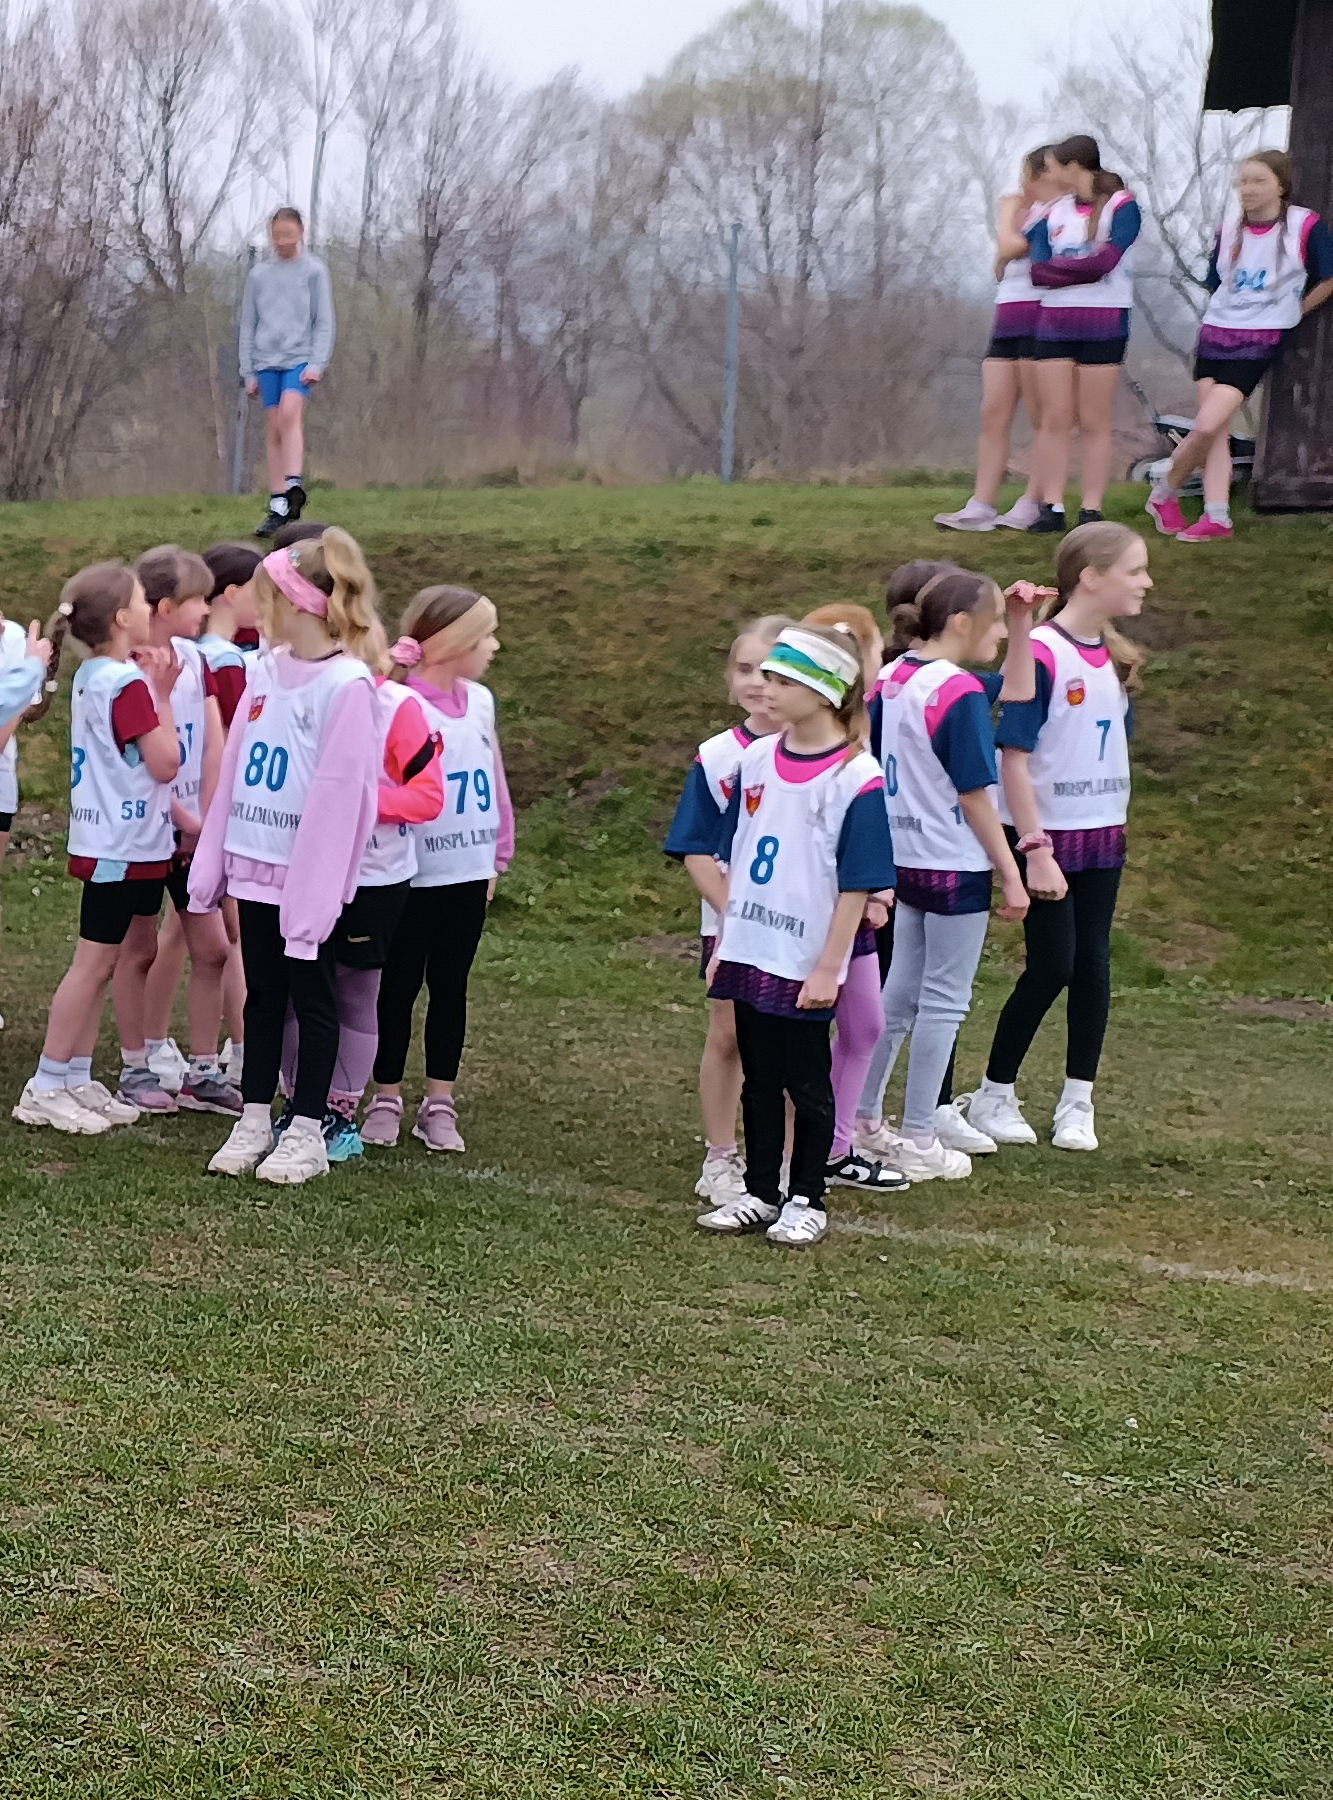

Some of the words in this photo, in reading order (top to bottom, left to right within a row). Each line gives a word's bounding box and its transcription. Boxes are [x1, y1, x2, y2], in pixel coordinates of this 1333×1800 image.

[1096, 719, 1111, 761] 7
[244, 741, 289, 792] 80
[121, 799, 148, 821] 58
[447, 768, 491, 815] 79
[749, 835, 780, 885] 8
